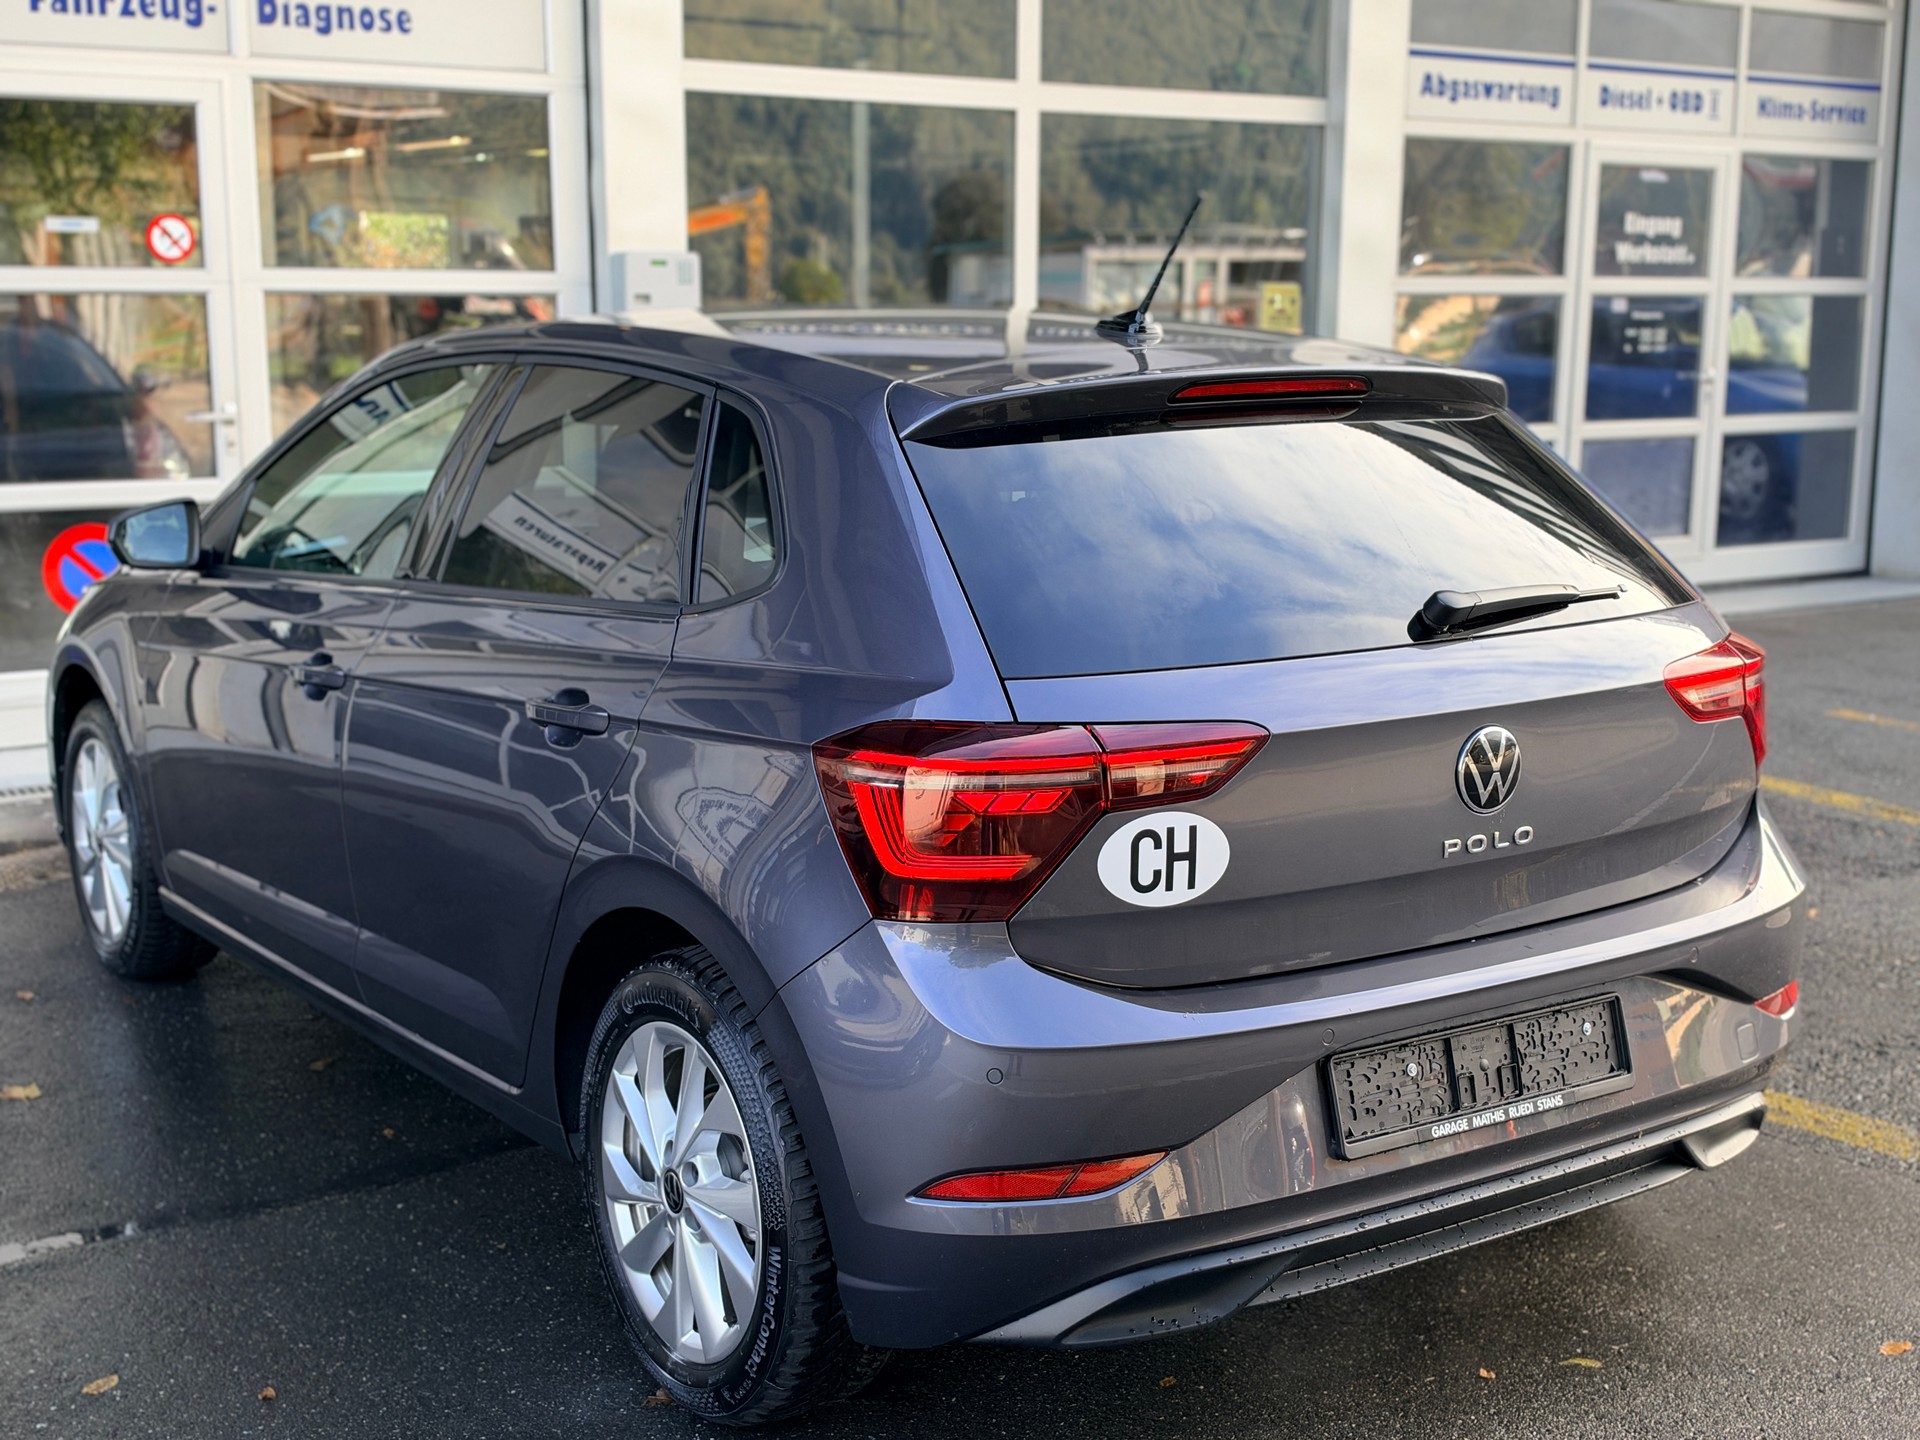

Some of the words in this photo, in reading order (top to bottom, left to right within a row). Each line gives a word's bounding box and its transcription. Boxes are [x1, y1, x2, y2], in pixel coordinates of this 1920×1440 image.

[256, 0, 413, 35] Diagnose
[1420, 71, 1561, 109] Abgaswartung
[1599, 84, 1652, 113] Diesel
[1130, 824, 1197, 894] CH
[1443, 825, 1534, 859] POLO
[1431, 1118, 1469, 1138] GARAGE
[1472, 1109, 1506, 1128] MATHIS
[1508, 1101, 1534, 1118] RUEDI
[1537, 1094, 1564, 1112] STANS
